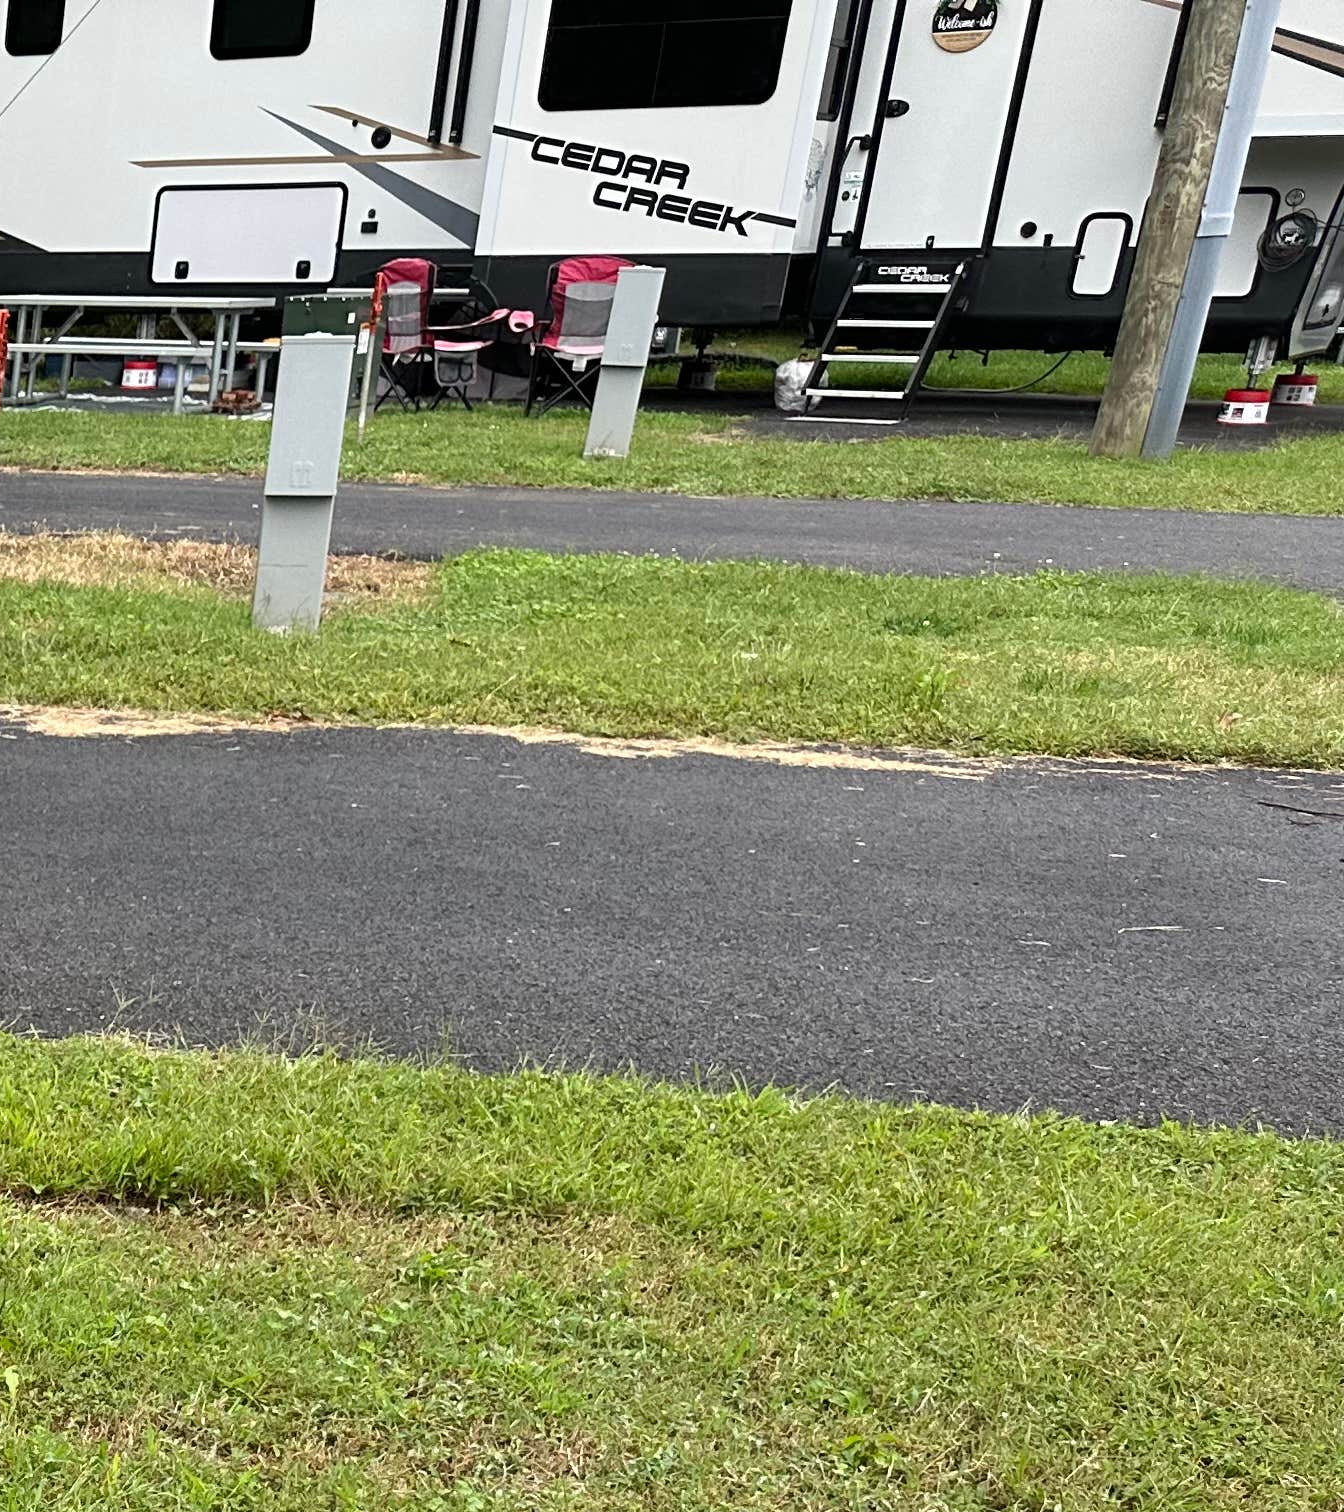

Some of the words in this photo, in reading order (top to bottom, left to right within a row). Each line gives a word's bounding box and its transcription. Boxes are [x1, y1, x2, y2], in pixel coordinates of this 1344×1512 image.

[531, 136, 690, 190] CEDAR
[593, 181, 756, 237] CREEK
[878, 266, 928, 275] CEDAR
[900, 273, 950, 283] CREEK
